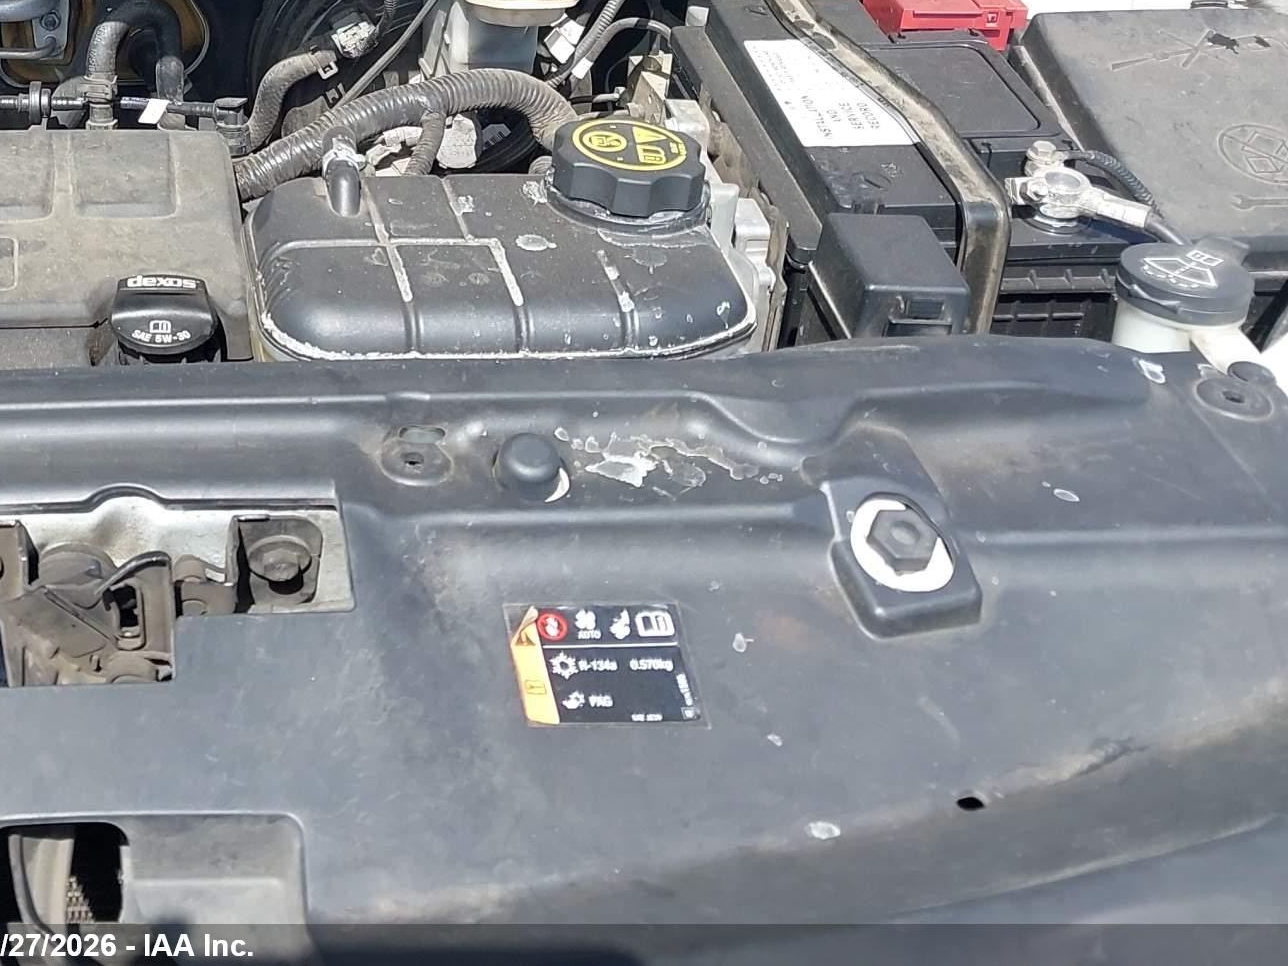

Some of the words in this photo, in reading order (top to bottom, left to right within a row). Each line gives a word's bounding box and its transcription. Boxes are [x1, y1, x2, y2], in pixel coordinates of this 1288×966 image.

[127, 275, 197, 289] dexos
[132, 329, 152, 343] SAE
[154, 330, 192, 344] 5W-30
